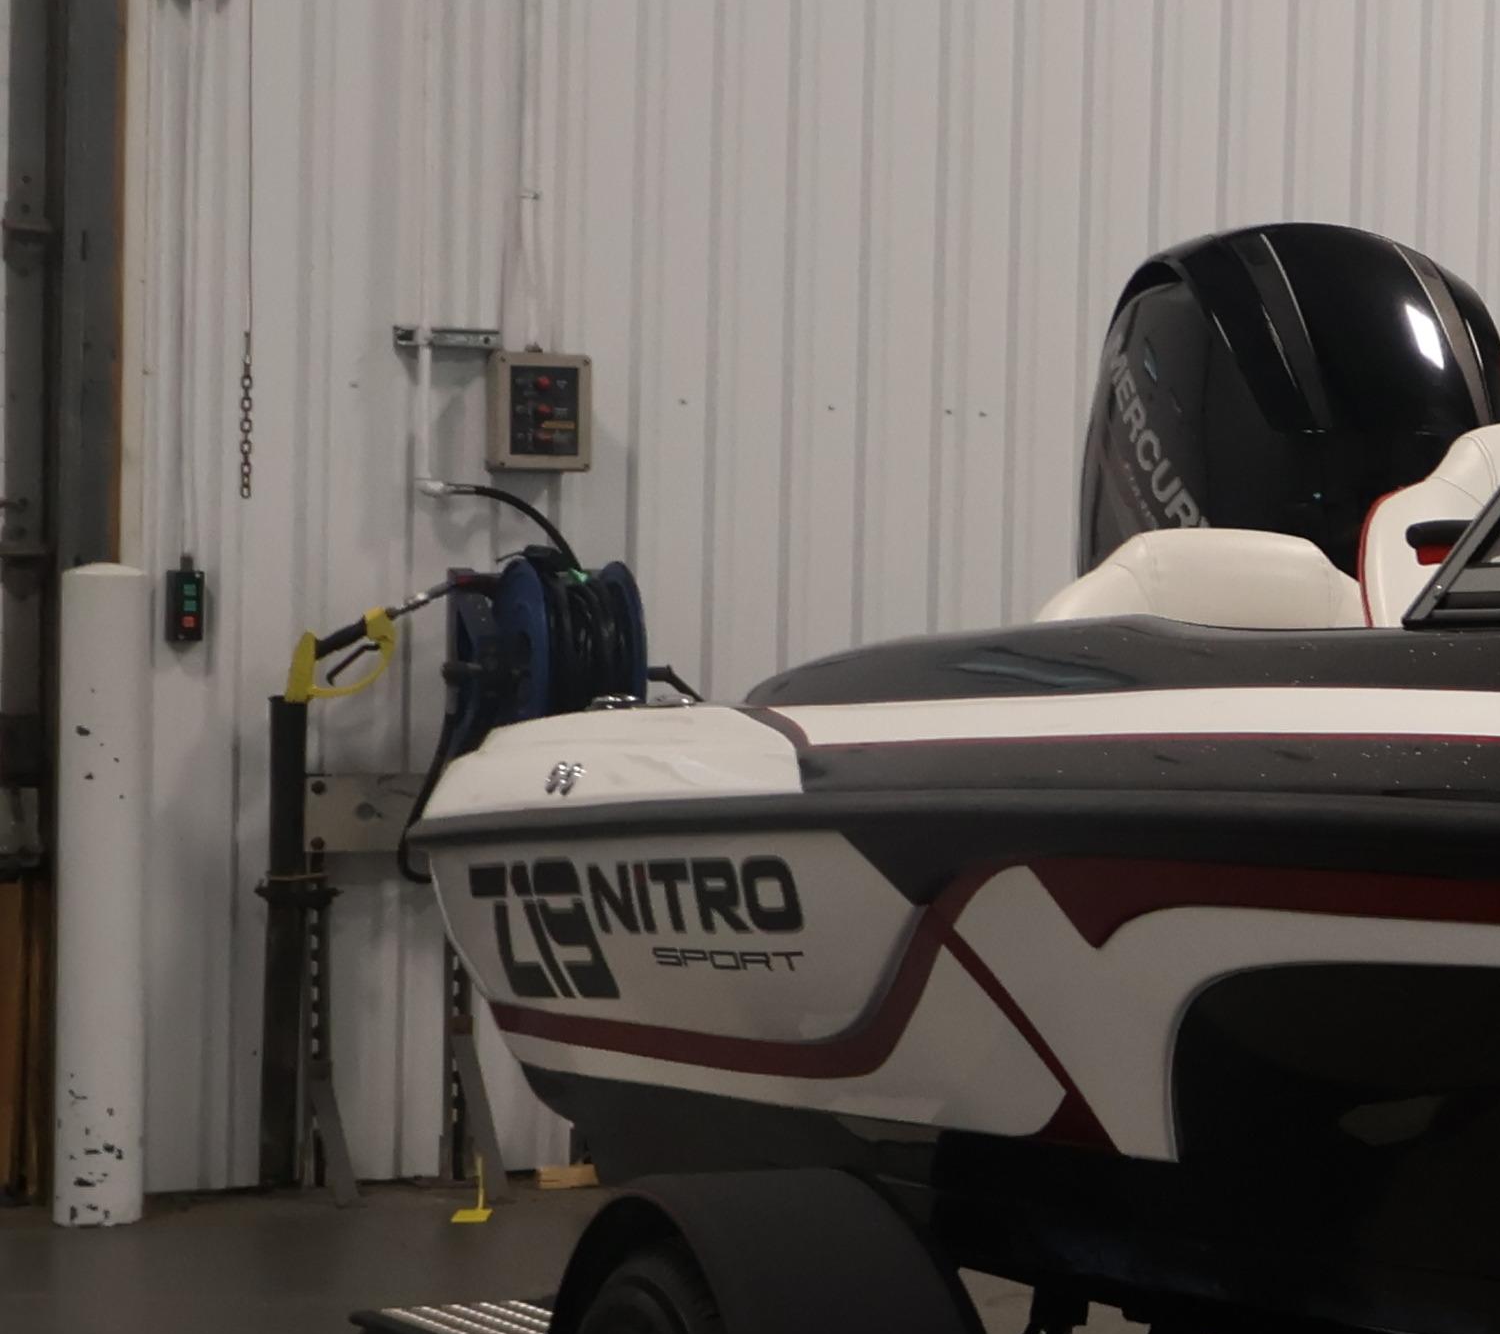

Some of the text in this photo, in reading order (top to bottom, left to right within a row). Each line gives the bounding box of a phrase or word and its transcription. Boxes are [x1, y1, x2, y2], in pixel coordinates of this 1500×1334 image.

[1108, 347, 1211, 529] MERCUR
[588, 855, 805, 935] NITRO
[651, 946, 805, 973] SPORT
